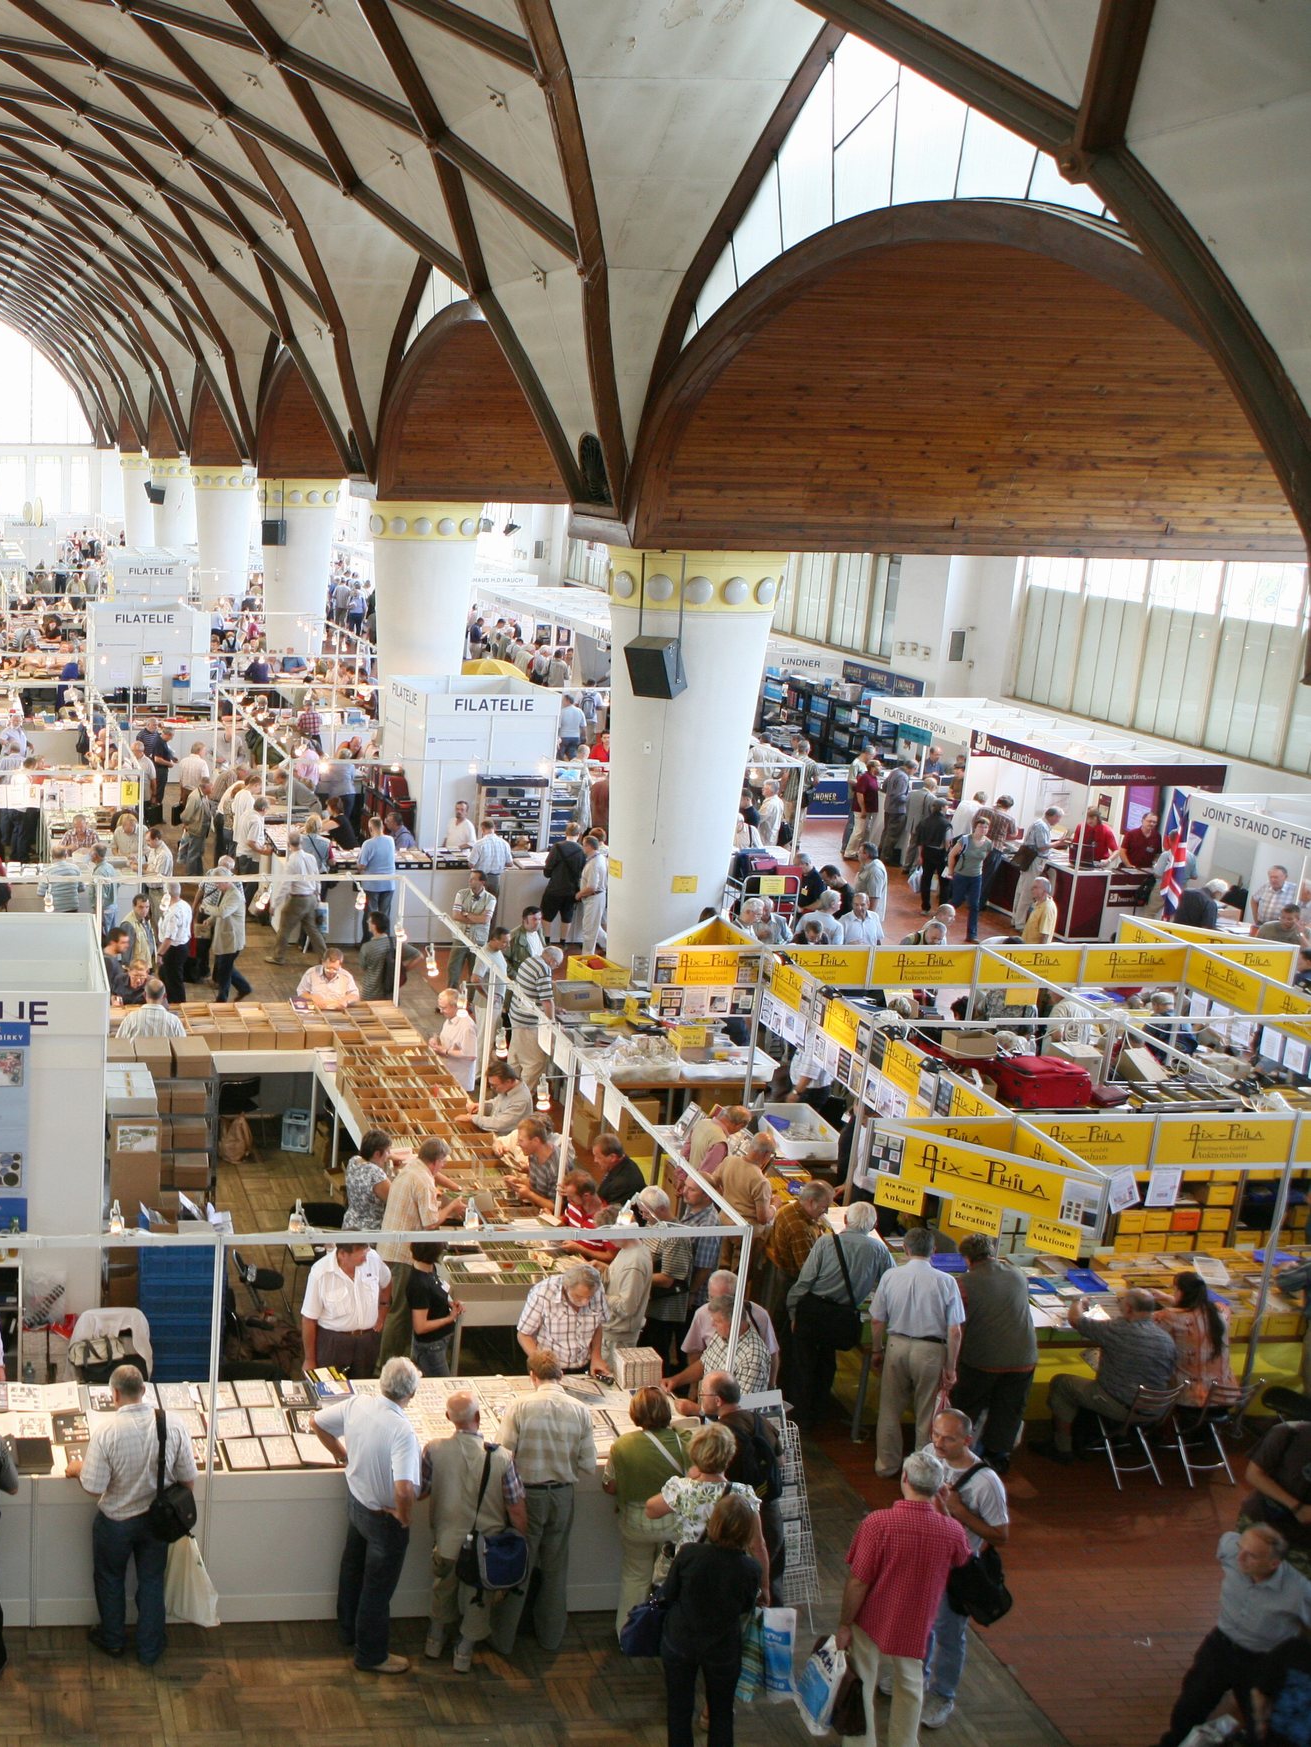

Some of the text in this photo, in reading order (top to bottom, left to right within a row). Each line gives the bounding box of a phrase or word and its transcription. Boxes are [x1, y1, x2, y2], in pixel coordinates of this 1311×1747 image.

[128, 567, 174, 575] FILATELIE
[115, 613, 174, 624] FILATELIE
[781, 657, 821, 668] LINDNER
[391, 682, 418, 706] FILATELIE
[454, 698, 534, 712] FILATELIE
[884, 707, 912, 724] FILATELIE
[912, 716, 929, 729] PETR
[929, 721, 946, 735] SOVA
[985, 740, 1011, 759] burda
[1011, 750, 1041, 769] auction,
[1101, 771, 1122, 780] burda
[1202, 807, 1311, 850] JOINT STAND OF THE
[882, 1191, 916, 1207] Ankauf
[955, 1211, 997, 1231] Beratung
[1031, 1233, 1075, 1250] Auktionen
